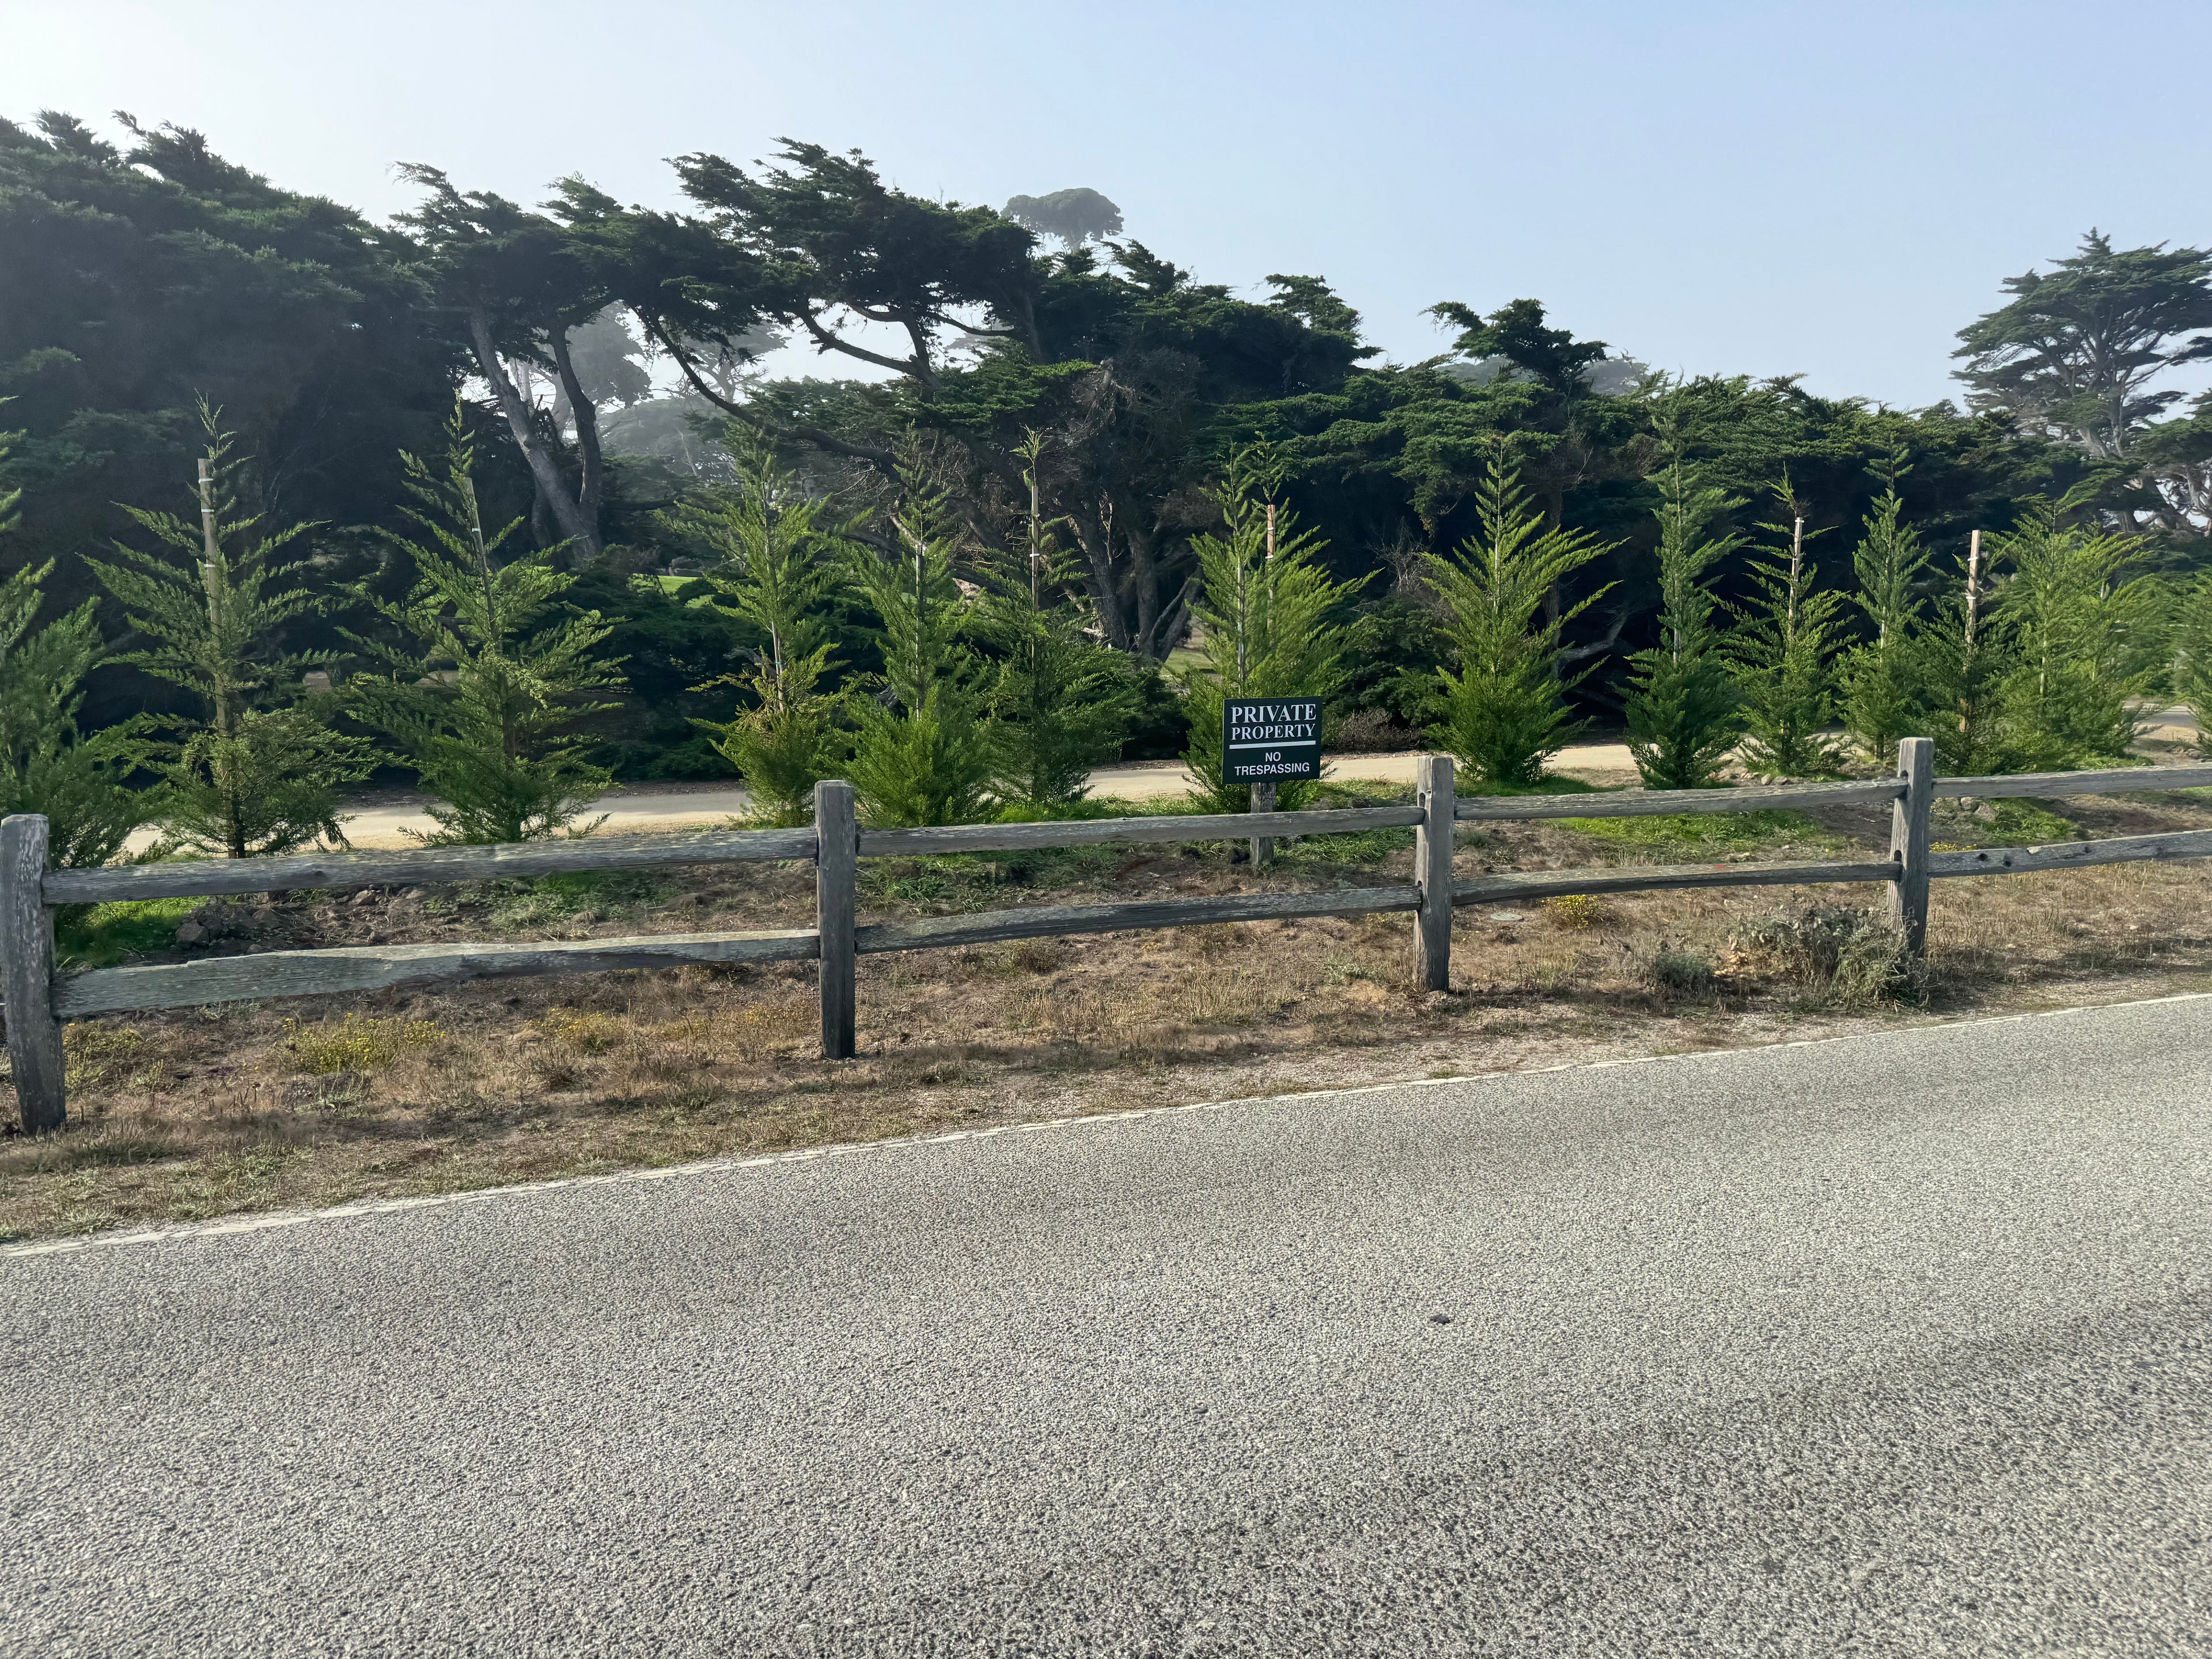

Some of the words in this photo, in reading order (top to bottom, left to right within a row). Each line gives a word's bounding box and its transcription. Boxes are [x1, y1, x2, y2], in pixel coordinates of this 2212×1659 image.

[1230, 703, 1316, 724] PRIVATE
[1231, 724, 1316, 741] PROPERTY
[1265, 752, 1281, 762] NO
[1234, 762, 1310, 776] TRESPASSING
